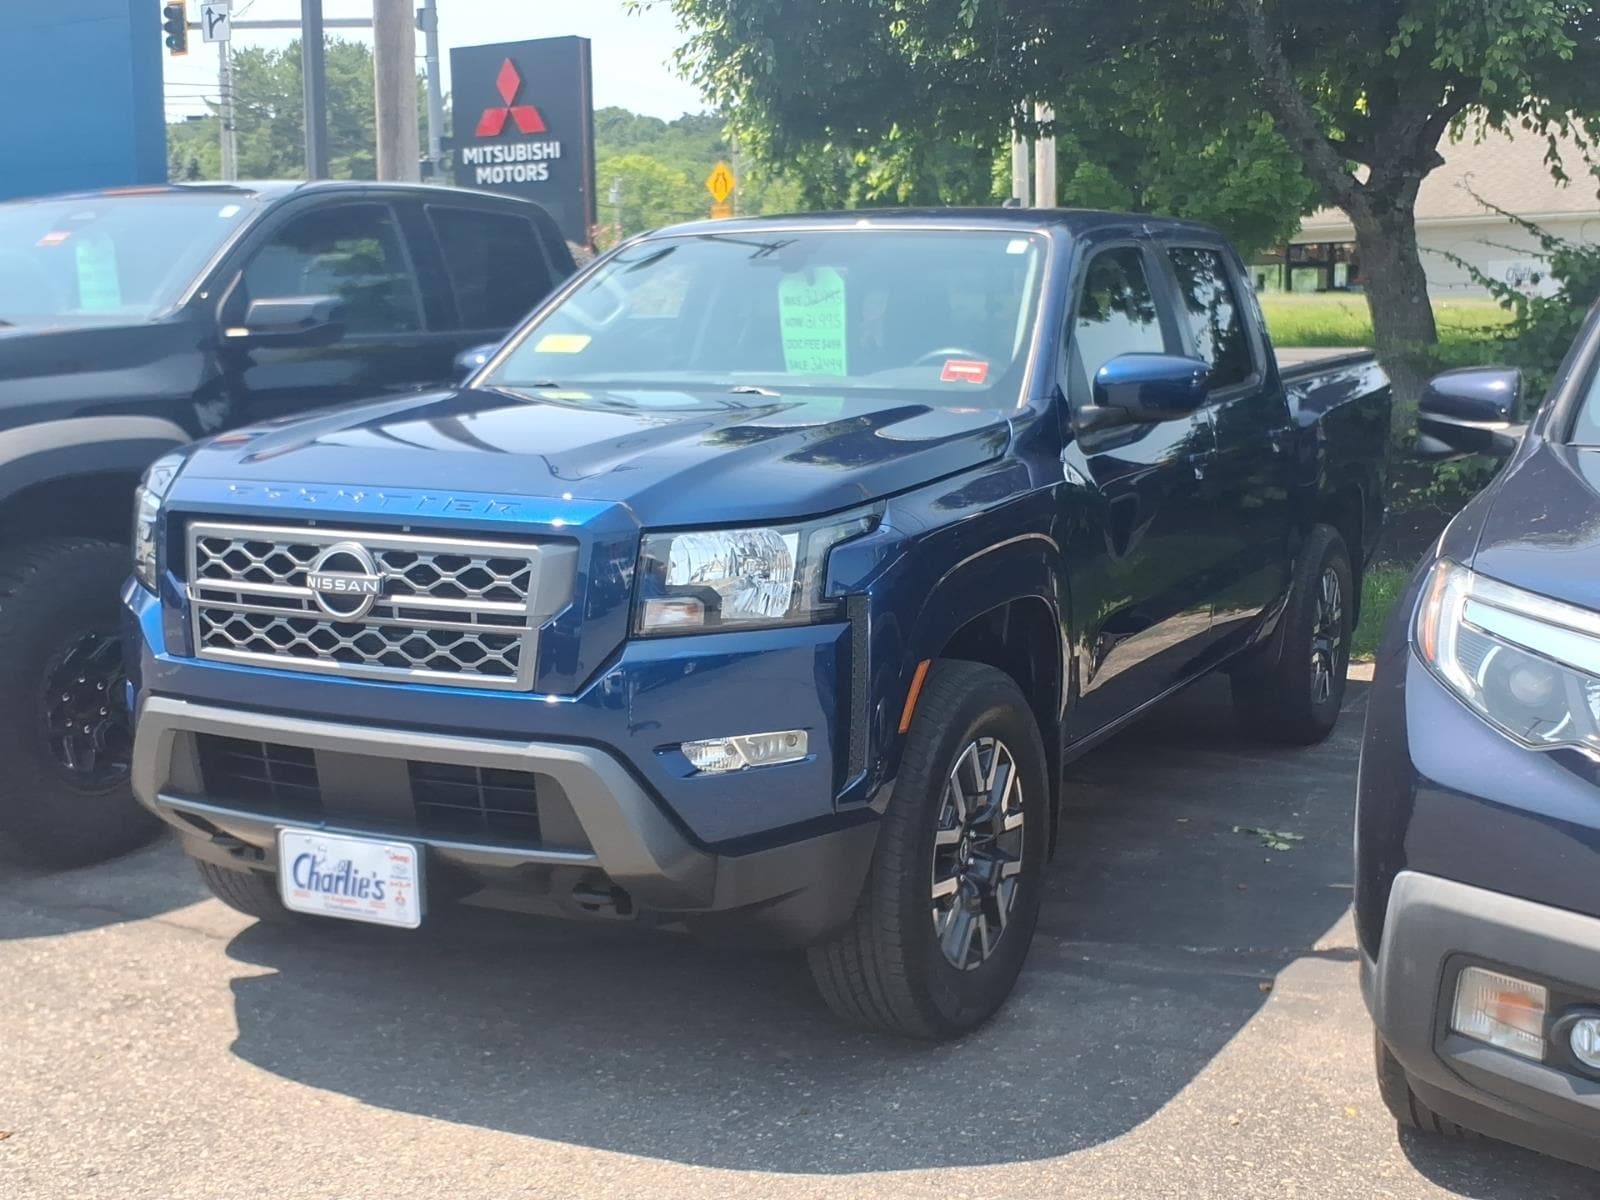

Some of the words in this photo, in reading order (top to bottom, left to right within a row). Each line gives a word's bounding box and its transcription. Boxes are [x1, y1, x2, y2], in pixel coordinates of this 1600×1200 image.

[463, 141, 560, 164] MITSUBISHI
[476, 163, 549, 184] MOTORS
[306, 575, 377, 592] NISSAN
[293, 852, 385, 900] Charlie's
